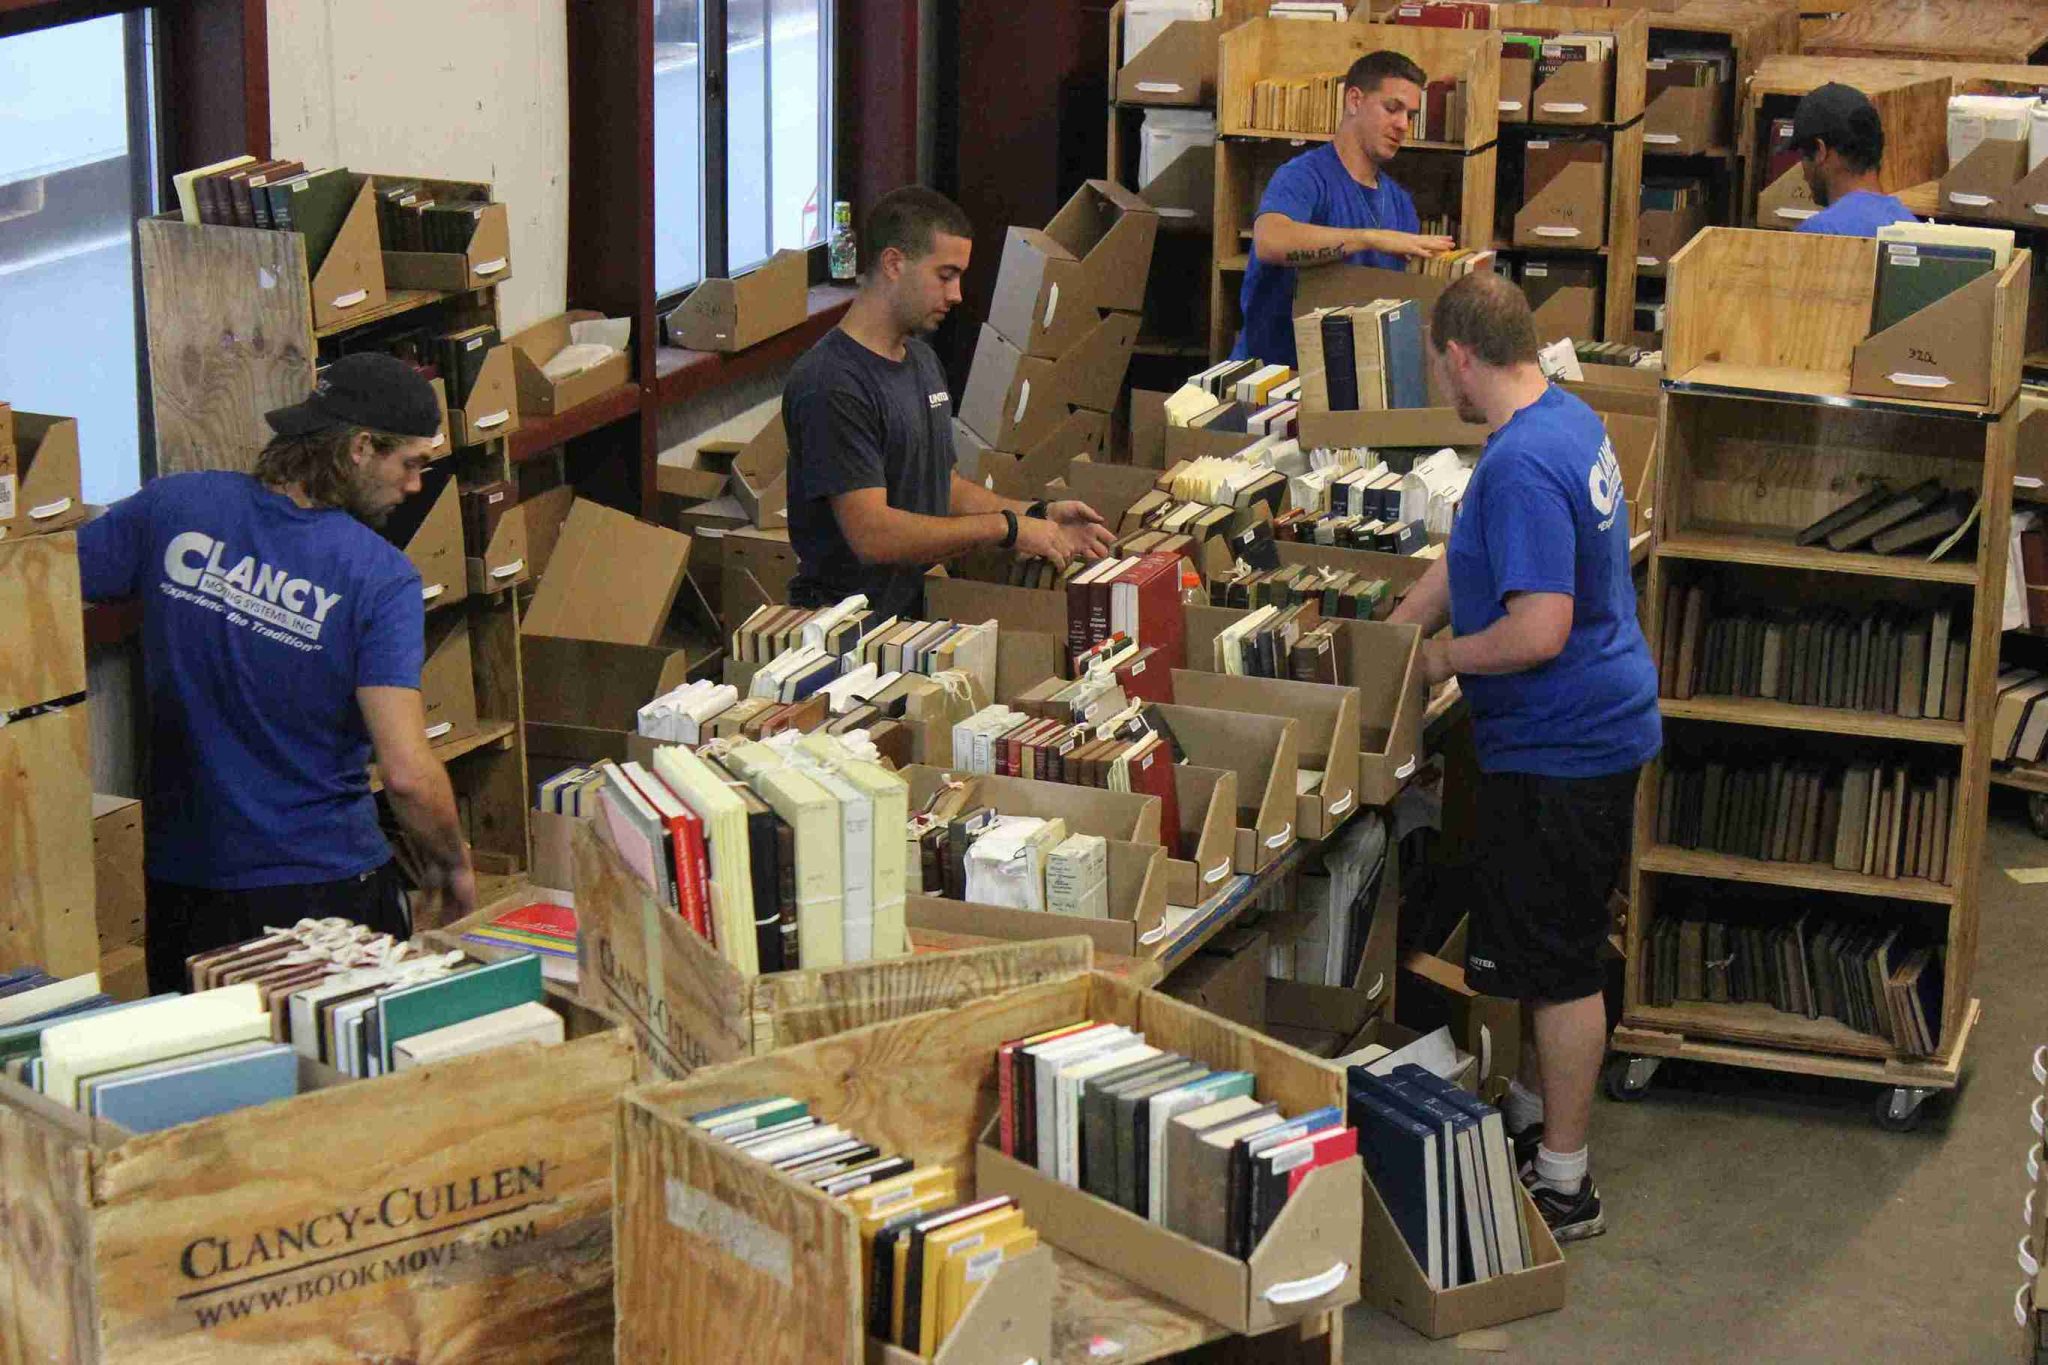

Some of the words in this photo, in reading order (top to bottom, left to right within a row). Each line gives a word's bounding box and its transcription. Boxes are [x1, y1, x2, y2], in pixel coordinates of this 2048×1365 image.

[164, 531, 342, 622] CLANCY
[204, 578, 243, 605] MOVING
[226, 611, 248, 627] the
[180, 1160, 545, 1280] CLANCY-CULLEN
[195, 1221, 537, 1329] WWW.BOOKMOVEOM
